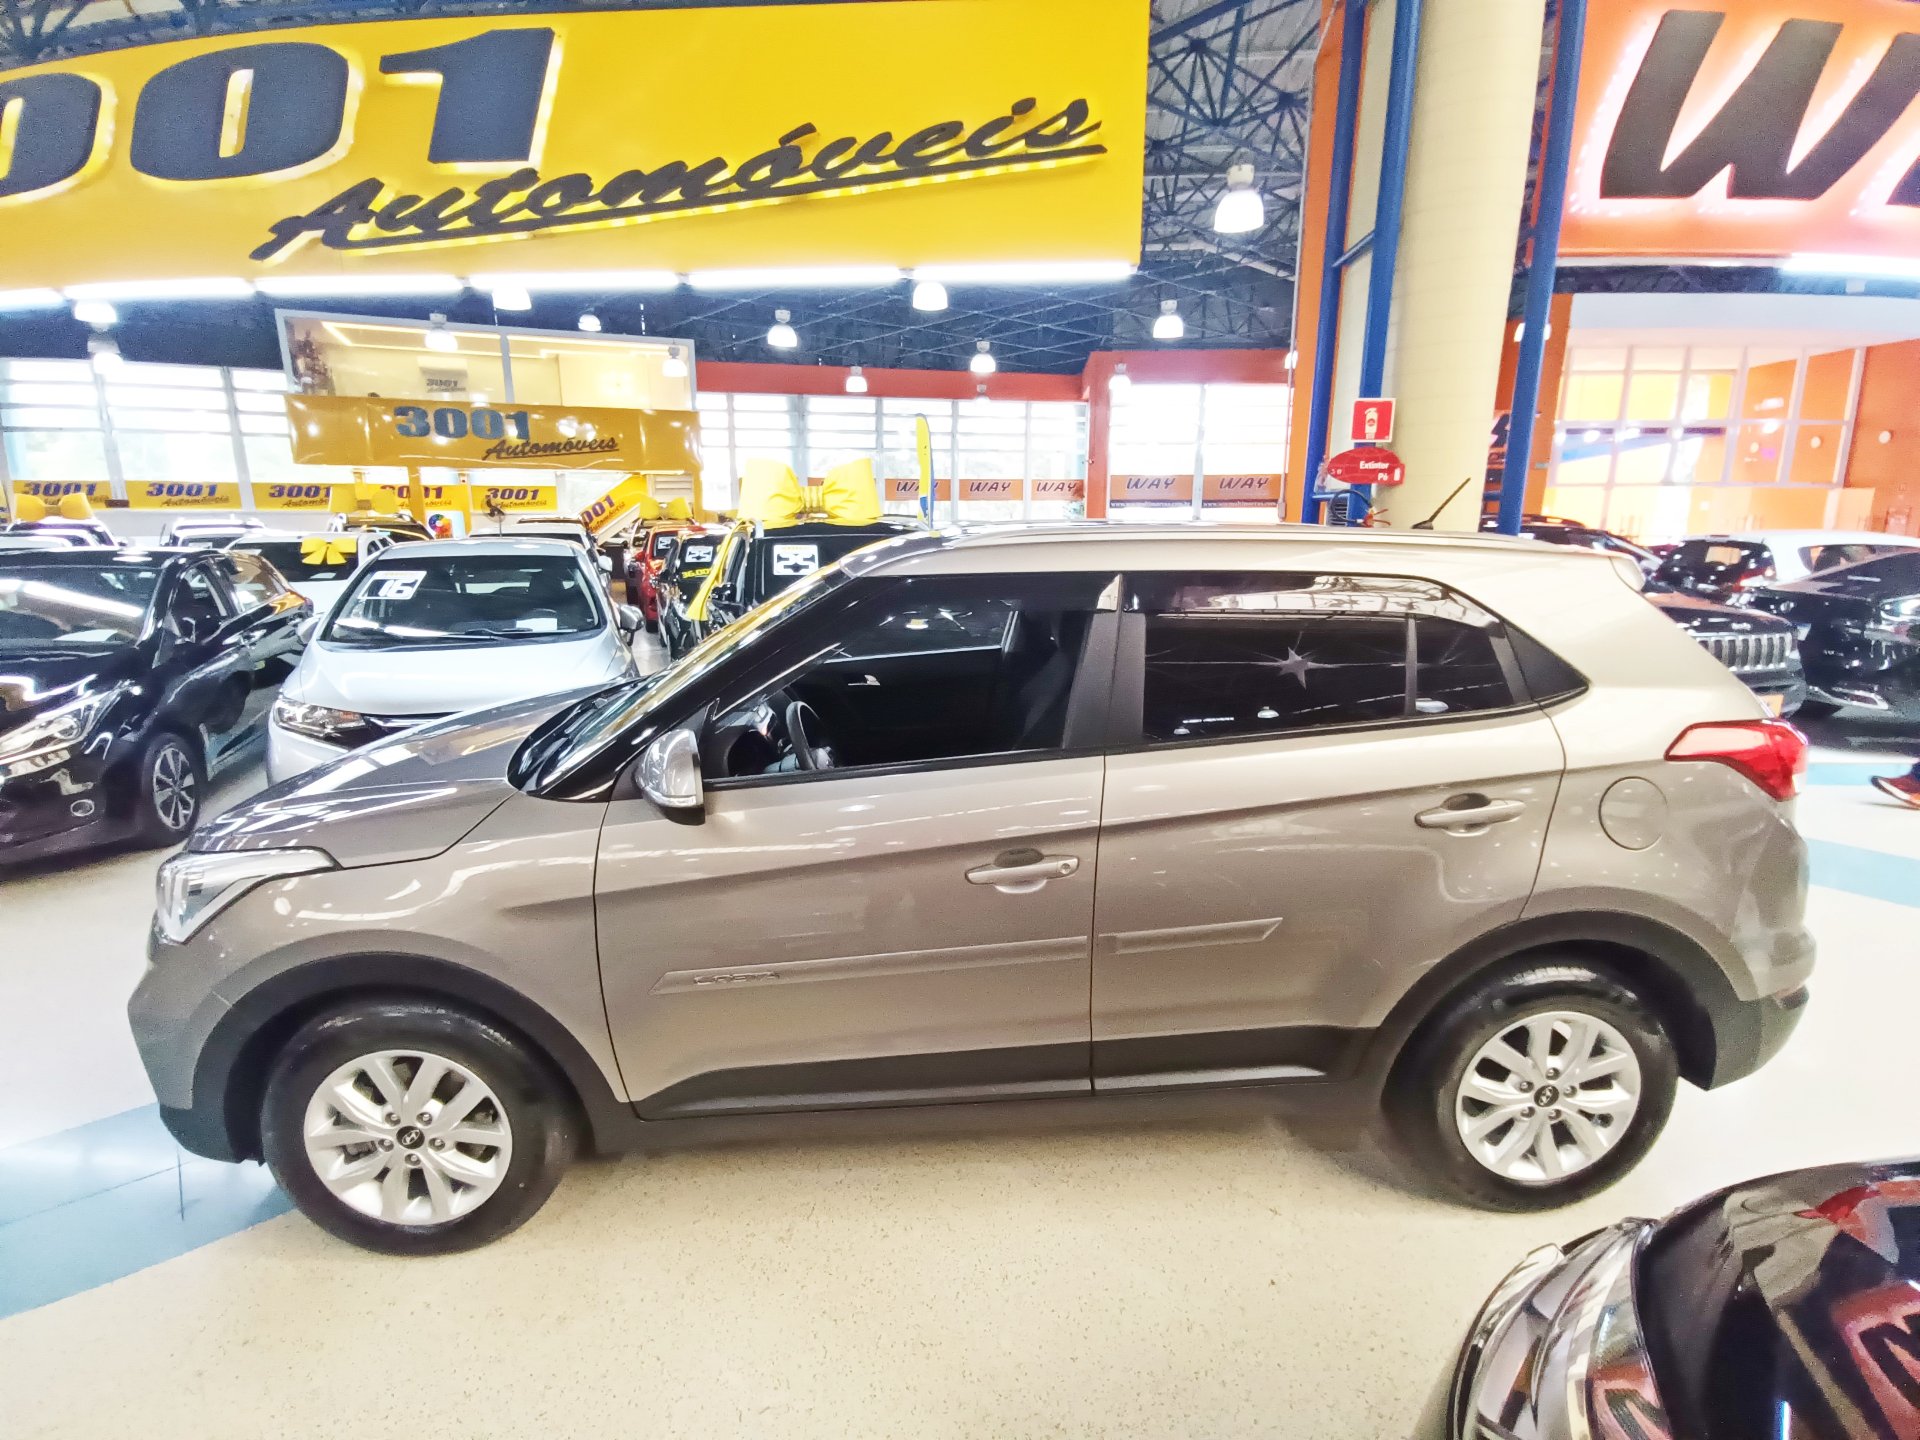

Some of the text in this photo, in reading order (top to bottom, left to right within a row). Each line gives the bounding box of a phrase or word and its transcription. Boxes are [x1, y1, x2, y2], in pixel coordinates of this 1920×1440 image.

[1600, 10, 1920, 205] W
[249, 98, 1107, 262] Automóveis
[394, 406, 530, 440] 3001
[481, 437, 620, 461] Automóveis
[1360, 461, 1389, 470] Extintor
[146, 483, 218, 497] 3001
[970, 482, 1011, 492] WAY
[1036, 482, 1077, 492] WAY
[1126, 477, 1176, 490] WAY
[1220, 477, 1270, 490] WAY
[268, 485, 331, 498] 3001
[486, 487, 539, 500] 3001
